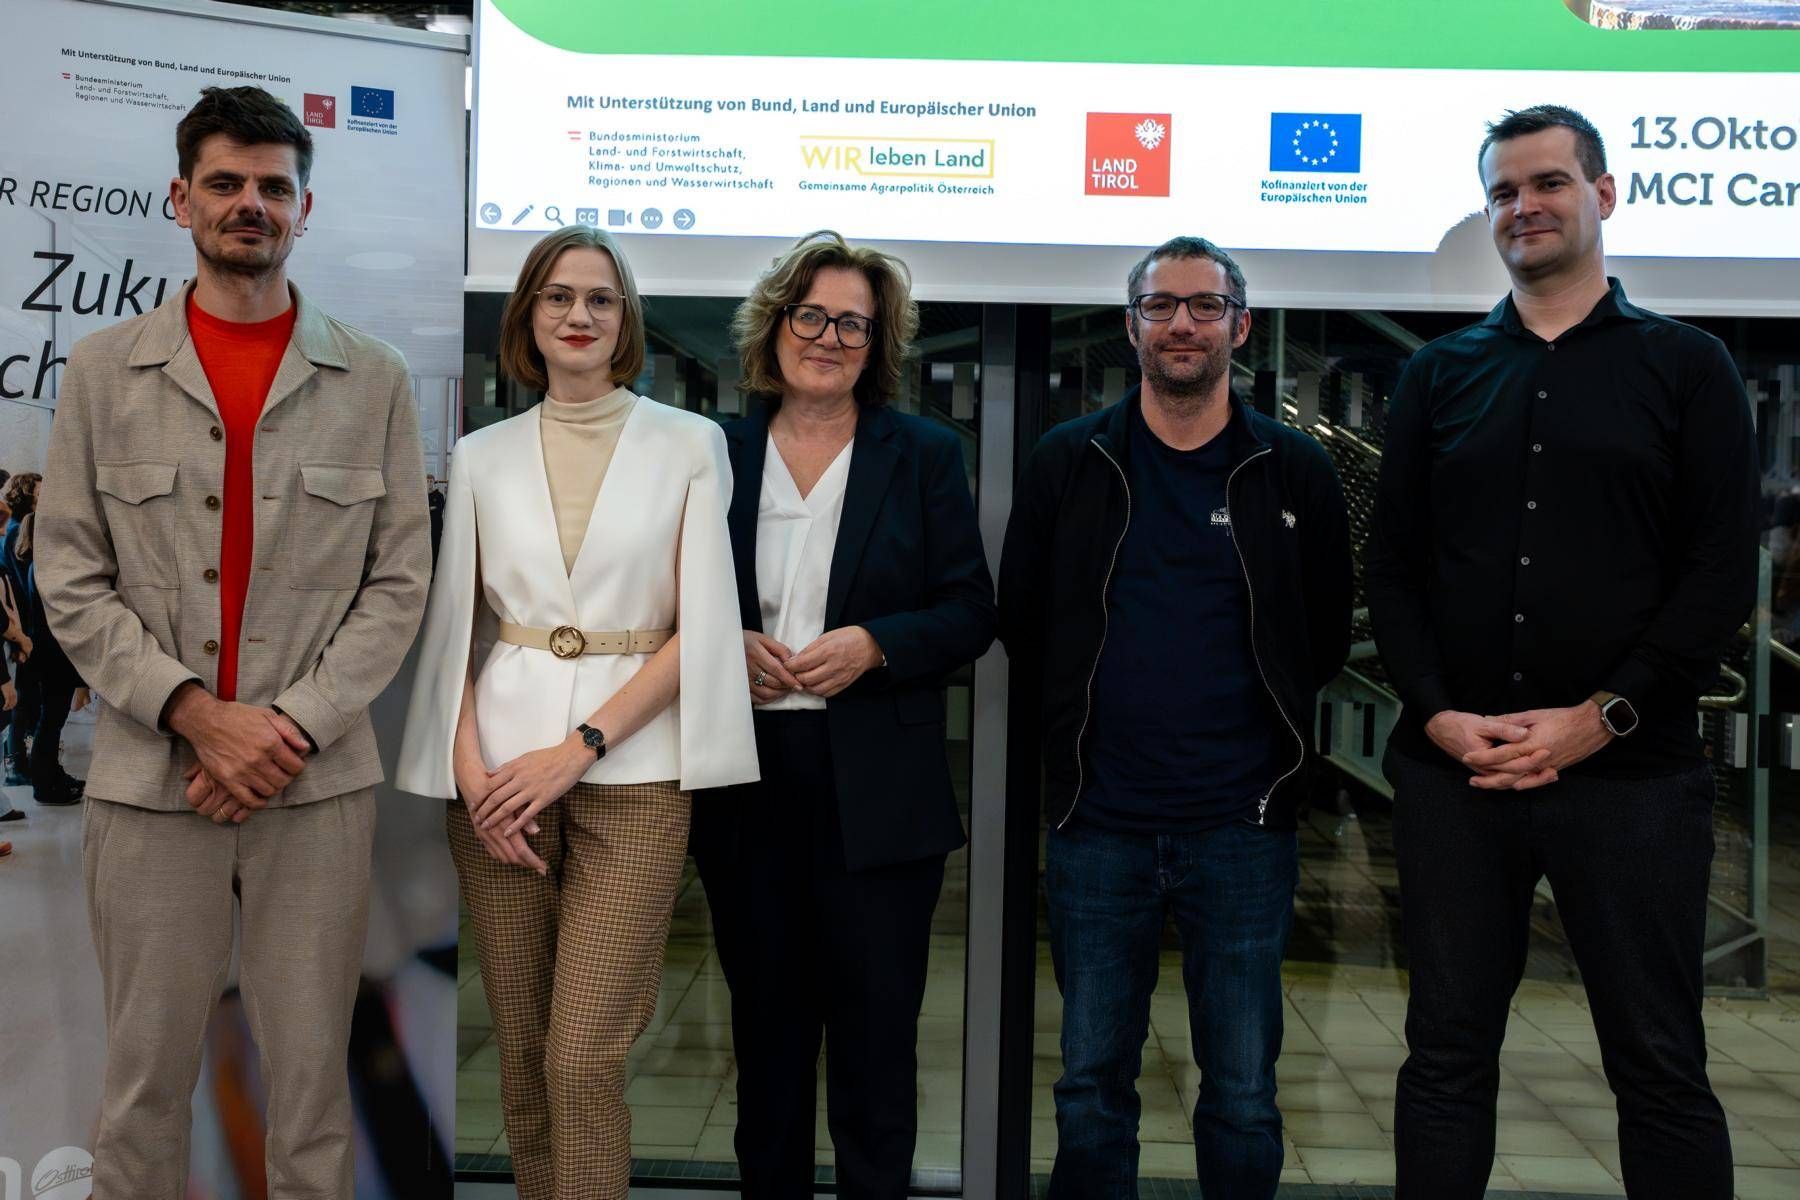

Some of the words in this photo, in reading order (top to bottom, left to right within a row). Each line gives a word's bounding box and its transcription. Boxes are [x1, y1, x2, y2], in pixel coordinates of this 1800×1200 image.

[61, 48, 76, 57] Mit
[78, 50, 136, 66] Unterstützung
[138, 59, 153, 67] von
[154, 60, 178, 71] Bund,
[179, 63, 198, 72] Land
[200, 66, 215, 74] und
[217, 68, 266, 80] Europäischer
[268, 74, 291, 84] Union
[75, 74, 143, 89] Bundesministerium
[75, 84, 96, 92] Land-
[75, 92, 108, 103] Regionen
[110, 96, 124, 104] und
[126, 98, 186, 112] Wasserwirtschaft
[567, 95, 594, 109] Mit
[600, 96, 712, 114] Unterstützung
[717, 100, 746, 111] von
[751, 98, 797, 114] Bund,
[802, 99, 840, 113] Land
[845, 101, 875, 113] und
[880, 101, 984, 118] Europäischer
[988, 103, 1037, 117] Union
[306, 111, 324, 120] LAND
[306, 117, 325, 126] TIROL
[347, 119, 378, 128] Kofinanziert
[347, 125, 382, 134] Europäischen
[382, 128, 398, 136] Union
[589, 131, 701, 143] Bundesministerium
[589, 146, 621, 157] Land-
[626, 146, 647, 157] und
[652, 147, 746, 160] Forstwirtschaft,
[801, 145, 862, 173] WIR
[870, 146, 926, 167] leben
[935, 149, 985, 168] Land
[588, 161, 625, 172] Klima-
[630, 162, 651, 172] und
[656, 162, 743, 175] Umweltschutz,
[1092, 158, 1137, 174] LAND
[588, 175, 642, 188] Regionen
[646, 176, 667, 188] und
[671, 177, 774, 190] Wasserwirtschaft
[799, 180, 867, 192] Gemeinsame
[870, 182, 934, 195] Agrarpolitik
[937, 182, 994, 195] Österreich
[1091, 173, 1139, 190] TIROL
[1261, 179, 1325, 192] Kofinanziert
[1328, 183, 1348, 192] von
[1350, 181, 1368, 192] der
[1627, 172, 1714, 206] MCI
[29, 180, 152, 218] REGION
[1261, 192, 1331, 204] Europäischen
[1335, 193, 1367, 204] Union
